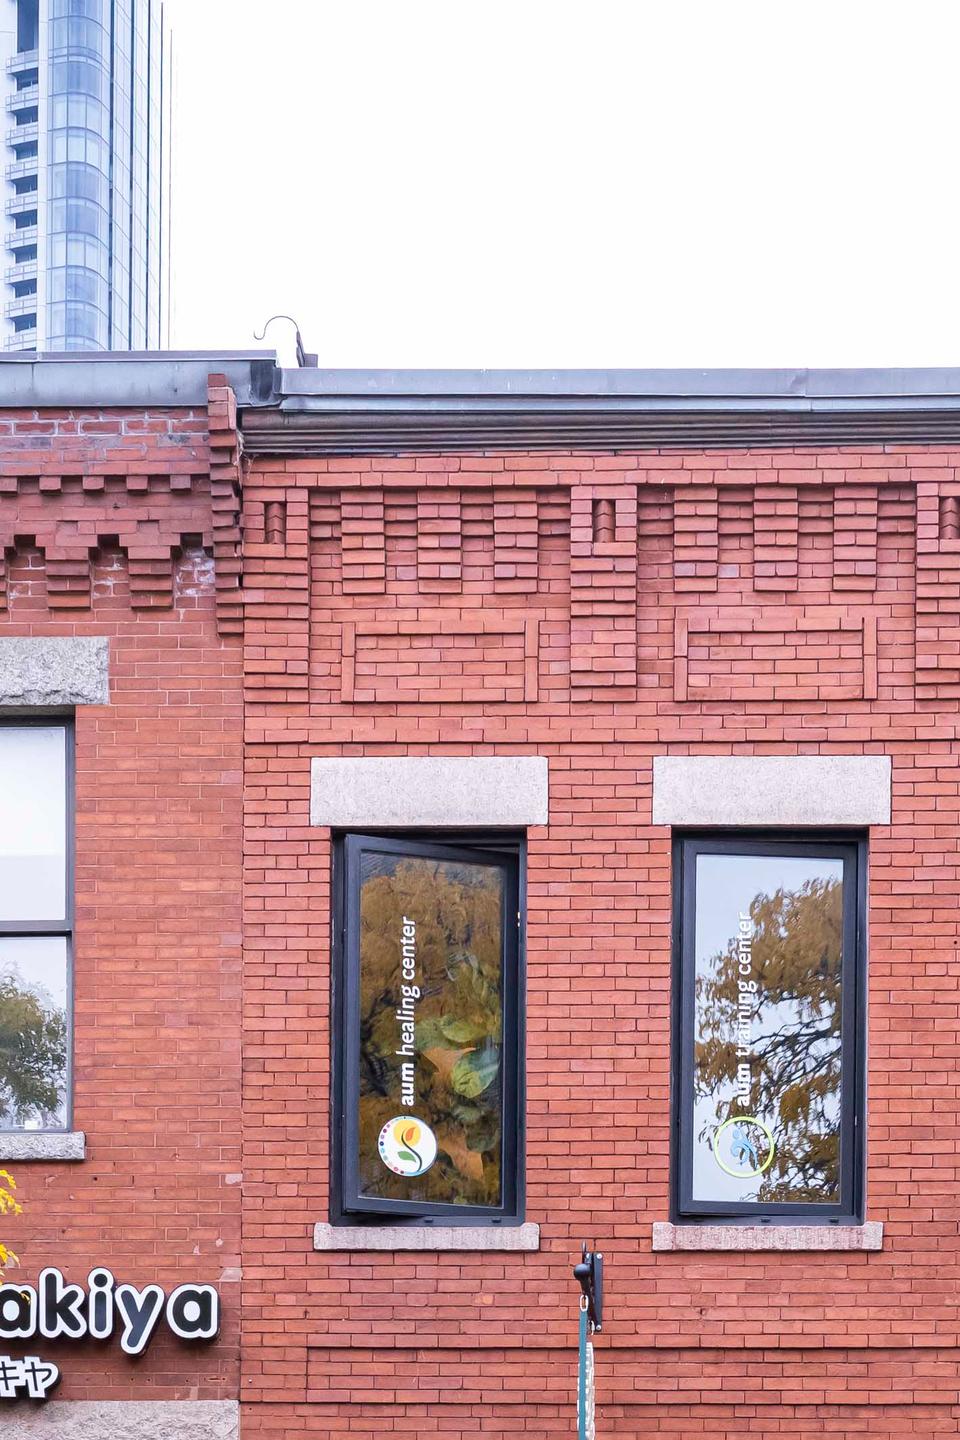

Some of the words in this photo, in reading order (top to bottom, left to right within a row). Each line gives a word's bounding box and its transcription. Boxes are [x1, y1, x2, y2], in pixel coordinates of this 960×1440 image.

[400, 916, 416, 980] center
[738, 912, 751, 975] center
[395, 985, 420, 1056] healing
[735, 980, 757, 1057] training
[401, 1063, 414, 1106] aum
[736, 1064, 750, 1107] aum
